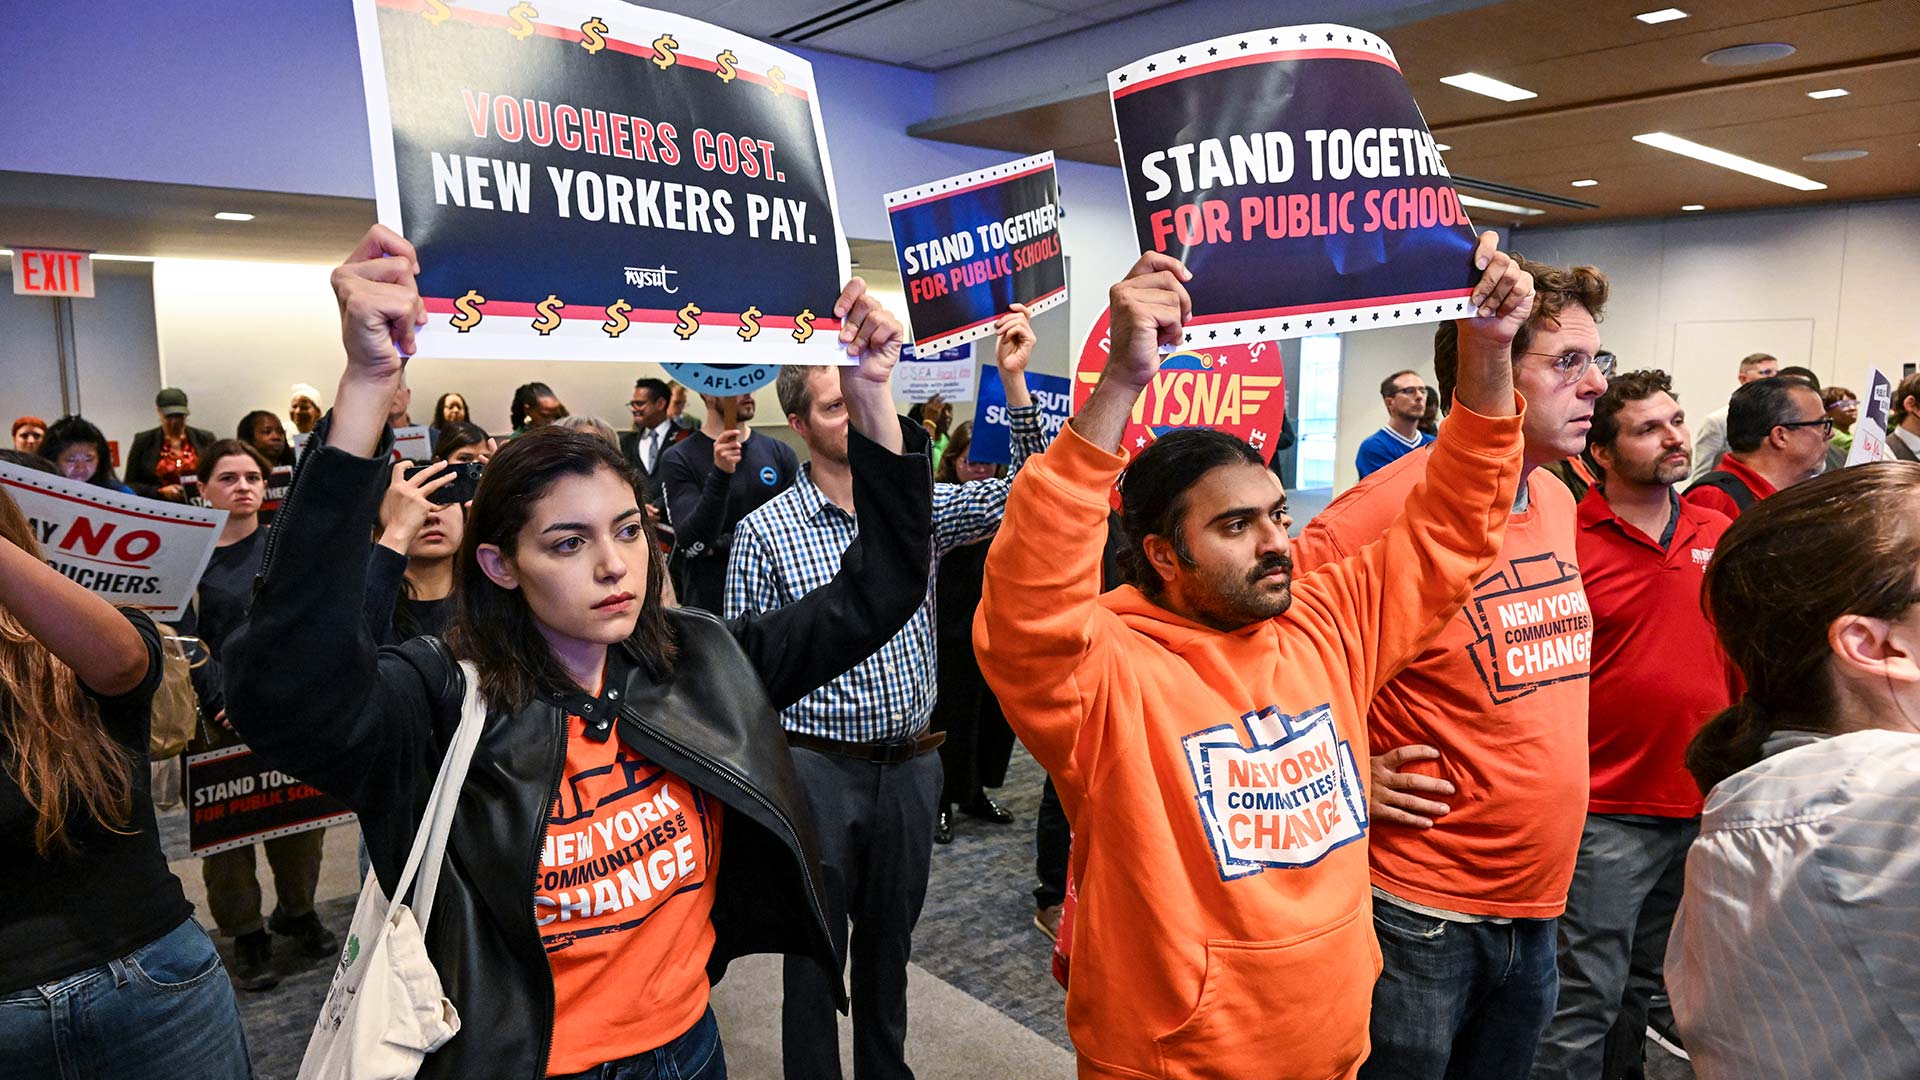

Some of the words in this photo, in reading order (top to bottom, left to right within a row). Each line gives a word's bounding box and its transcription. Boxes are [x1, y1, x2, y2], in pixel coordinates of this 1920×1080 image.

[461, 89, 681, 166] VOUCHERS
[693, 128, 786, 183] COST.
[1141, 131, 1295, 202] STAND
[1305, 127, 1451, 181] TOGETHE
[430, 151, 531, 214] NEW
[546, 166, 735, 236] YORKERS
[746, 193, 817, 245] PAY.
[1150, 199, 1232, 253] FOR
[1241, 190, 1355, 241] PUBLIC
[1363, 186, 1470, 233] SCHOOL
[904, 230, 975, 275] STAND
[976, 203, 1058, 253] TOGETHER
[21, 250, 82, 292] EXIT
[909, 273, 949, 304] FOR
[950, 252, 1013, 292] PUBLIC
[1014, 234, 1060, 272] SCHOOLS
[704, 368, 766, 389] AFL-CIO
[1030, 389, 1071, 413] SUT
[58, 516, 161, 562] NO
[46, 559, 162, 594] UCHERS.
[1497, 598, 1544, 629] NEW
[1545, 589, 1589, 619] YORK
[1504, 615, 1588, 645] COMMUNITIES
[1506, 631, 1592, 677] CHANGE
[194, 775, 255, 807] STAND
[194, 804, 225, 825] FOR
[229, 789, 283, 815] PUBLIC
[1228, 774, 1334, 811] COMMNITIES
[540, 825, 594, 867] NEW
[592, 783, 681, 851] YORK
[676, 811, 688, 834] FOR
[1228, 790, 1342, 850] CHANGE
[533, 834, 697, 927] CHANGE
